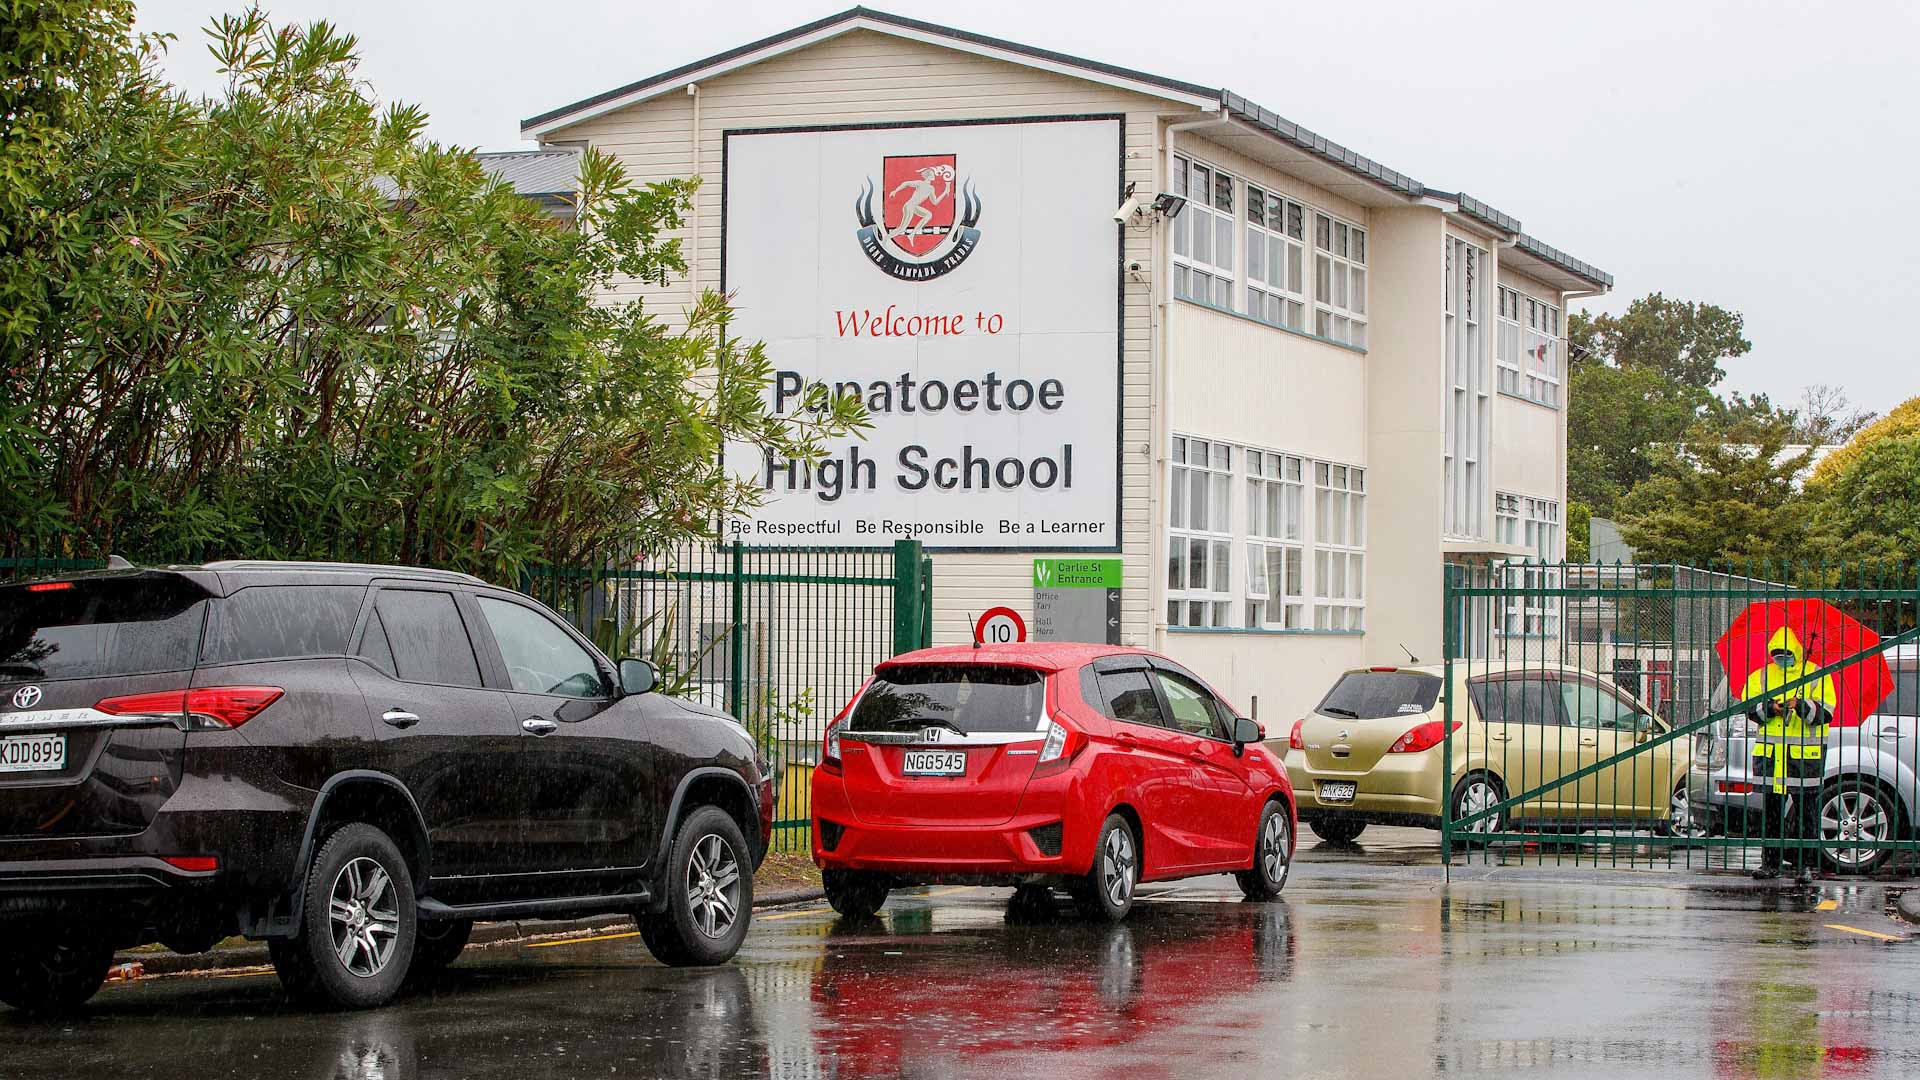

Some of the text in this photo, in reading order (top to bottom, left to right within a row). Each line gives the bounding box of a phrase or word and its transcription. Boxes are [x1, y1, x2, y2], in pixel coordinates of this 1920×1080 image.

[893, 264, 936, 278] LAMPADA
[943, 238, 974, 269] TRADAS
[835, 304, 1004, 337] Welcome to
[897, 444, 1072, 490] School
[731, 520, 841, 536] Be Respectful
[856, 519, 984, 536] Be Responsible
[999, 519, 1106, 534] Be a Learner
[1058, 563, 1102, 572] Carlie St
[1058, 574, 1104, 584] Entrance
[1036, 592, 1060, 601] Office
[991, 624, 1011, 643] 10
[0, 741, 63, 764] KDD899
[906, 754, 963, 770] NGG545
